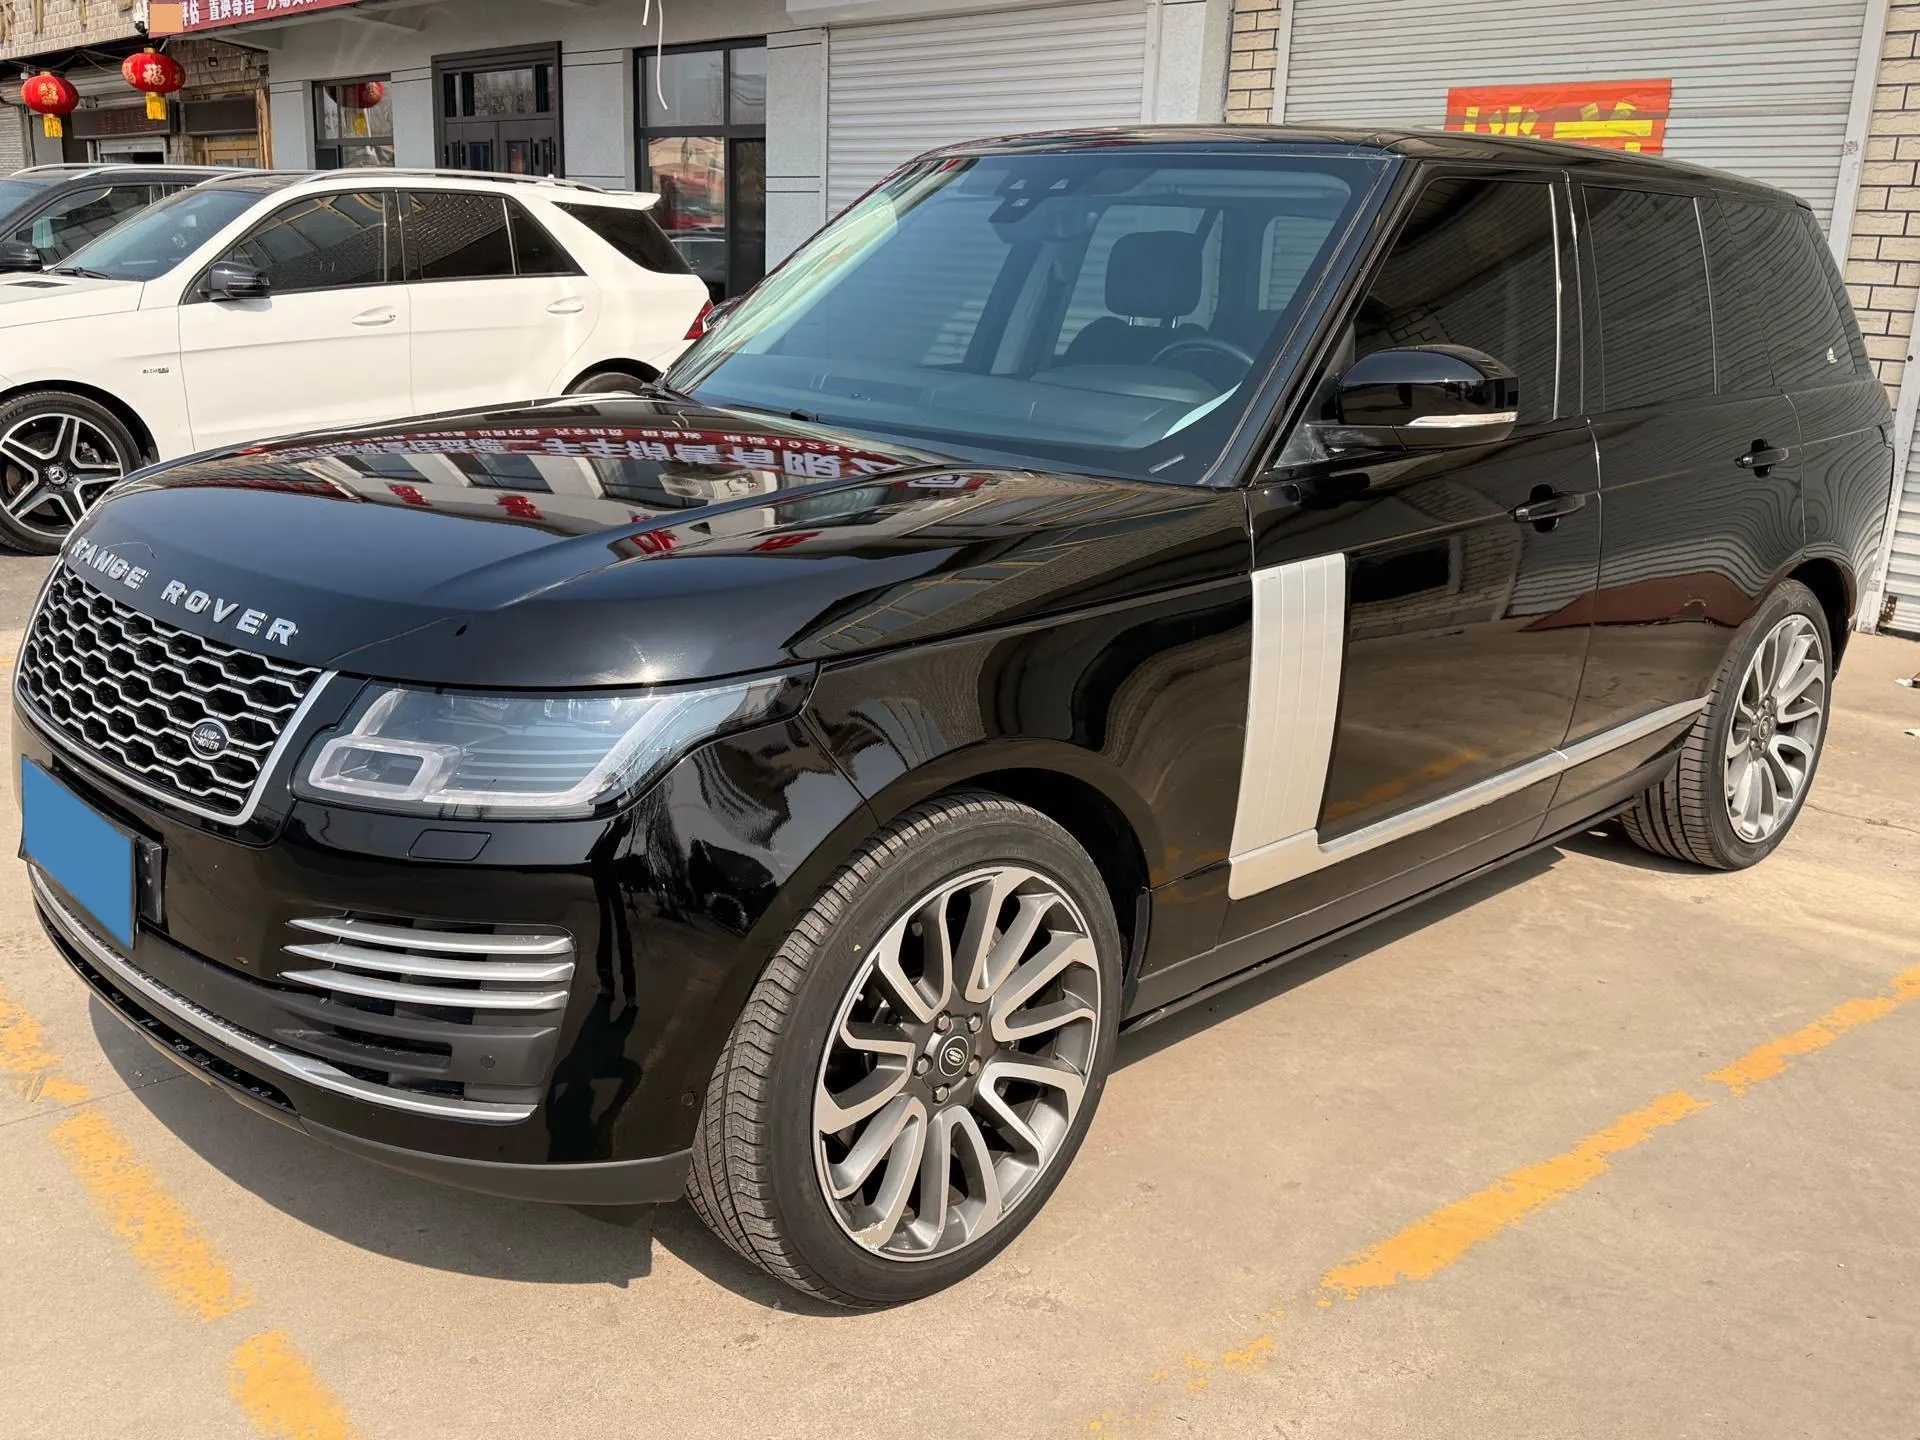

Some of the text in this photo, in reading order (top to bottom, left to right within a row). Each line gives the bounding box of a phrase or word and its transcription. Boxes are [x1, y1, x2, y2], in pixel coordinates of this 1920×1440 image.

[143, 64, 165, 85] 福
[70, 536, 299, 646] RANGE ROVER
[199, 727, 218, 740] LAND
[197, 737, 220, 750] ROVER
